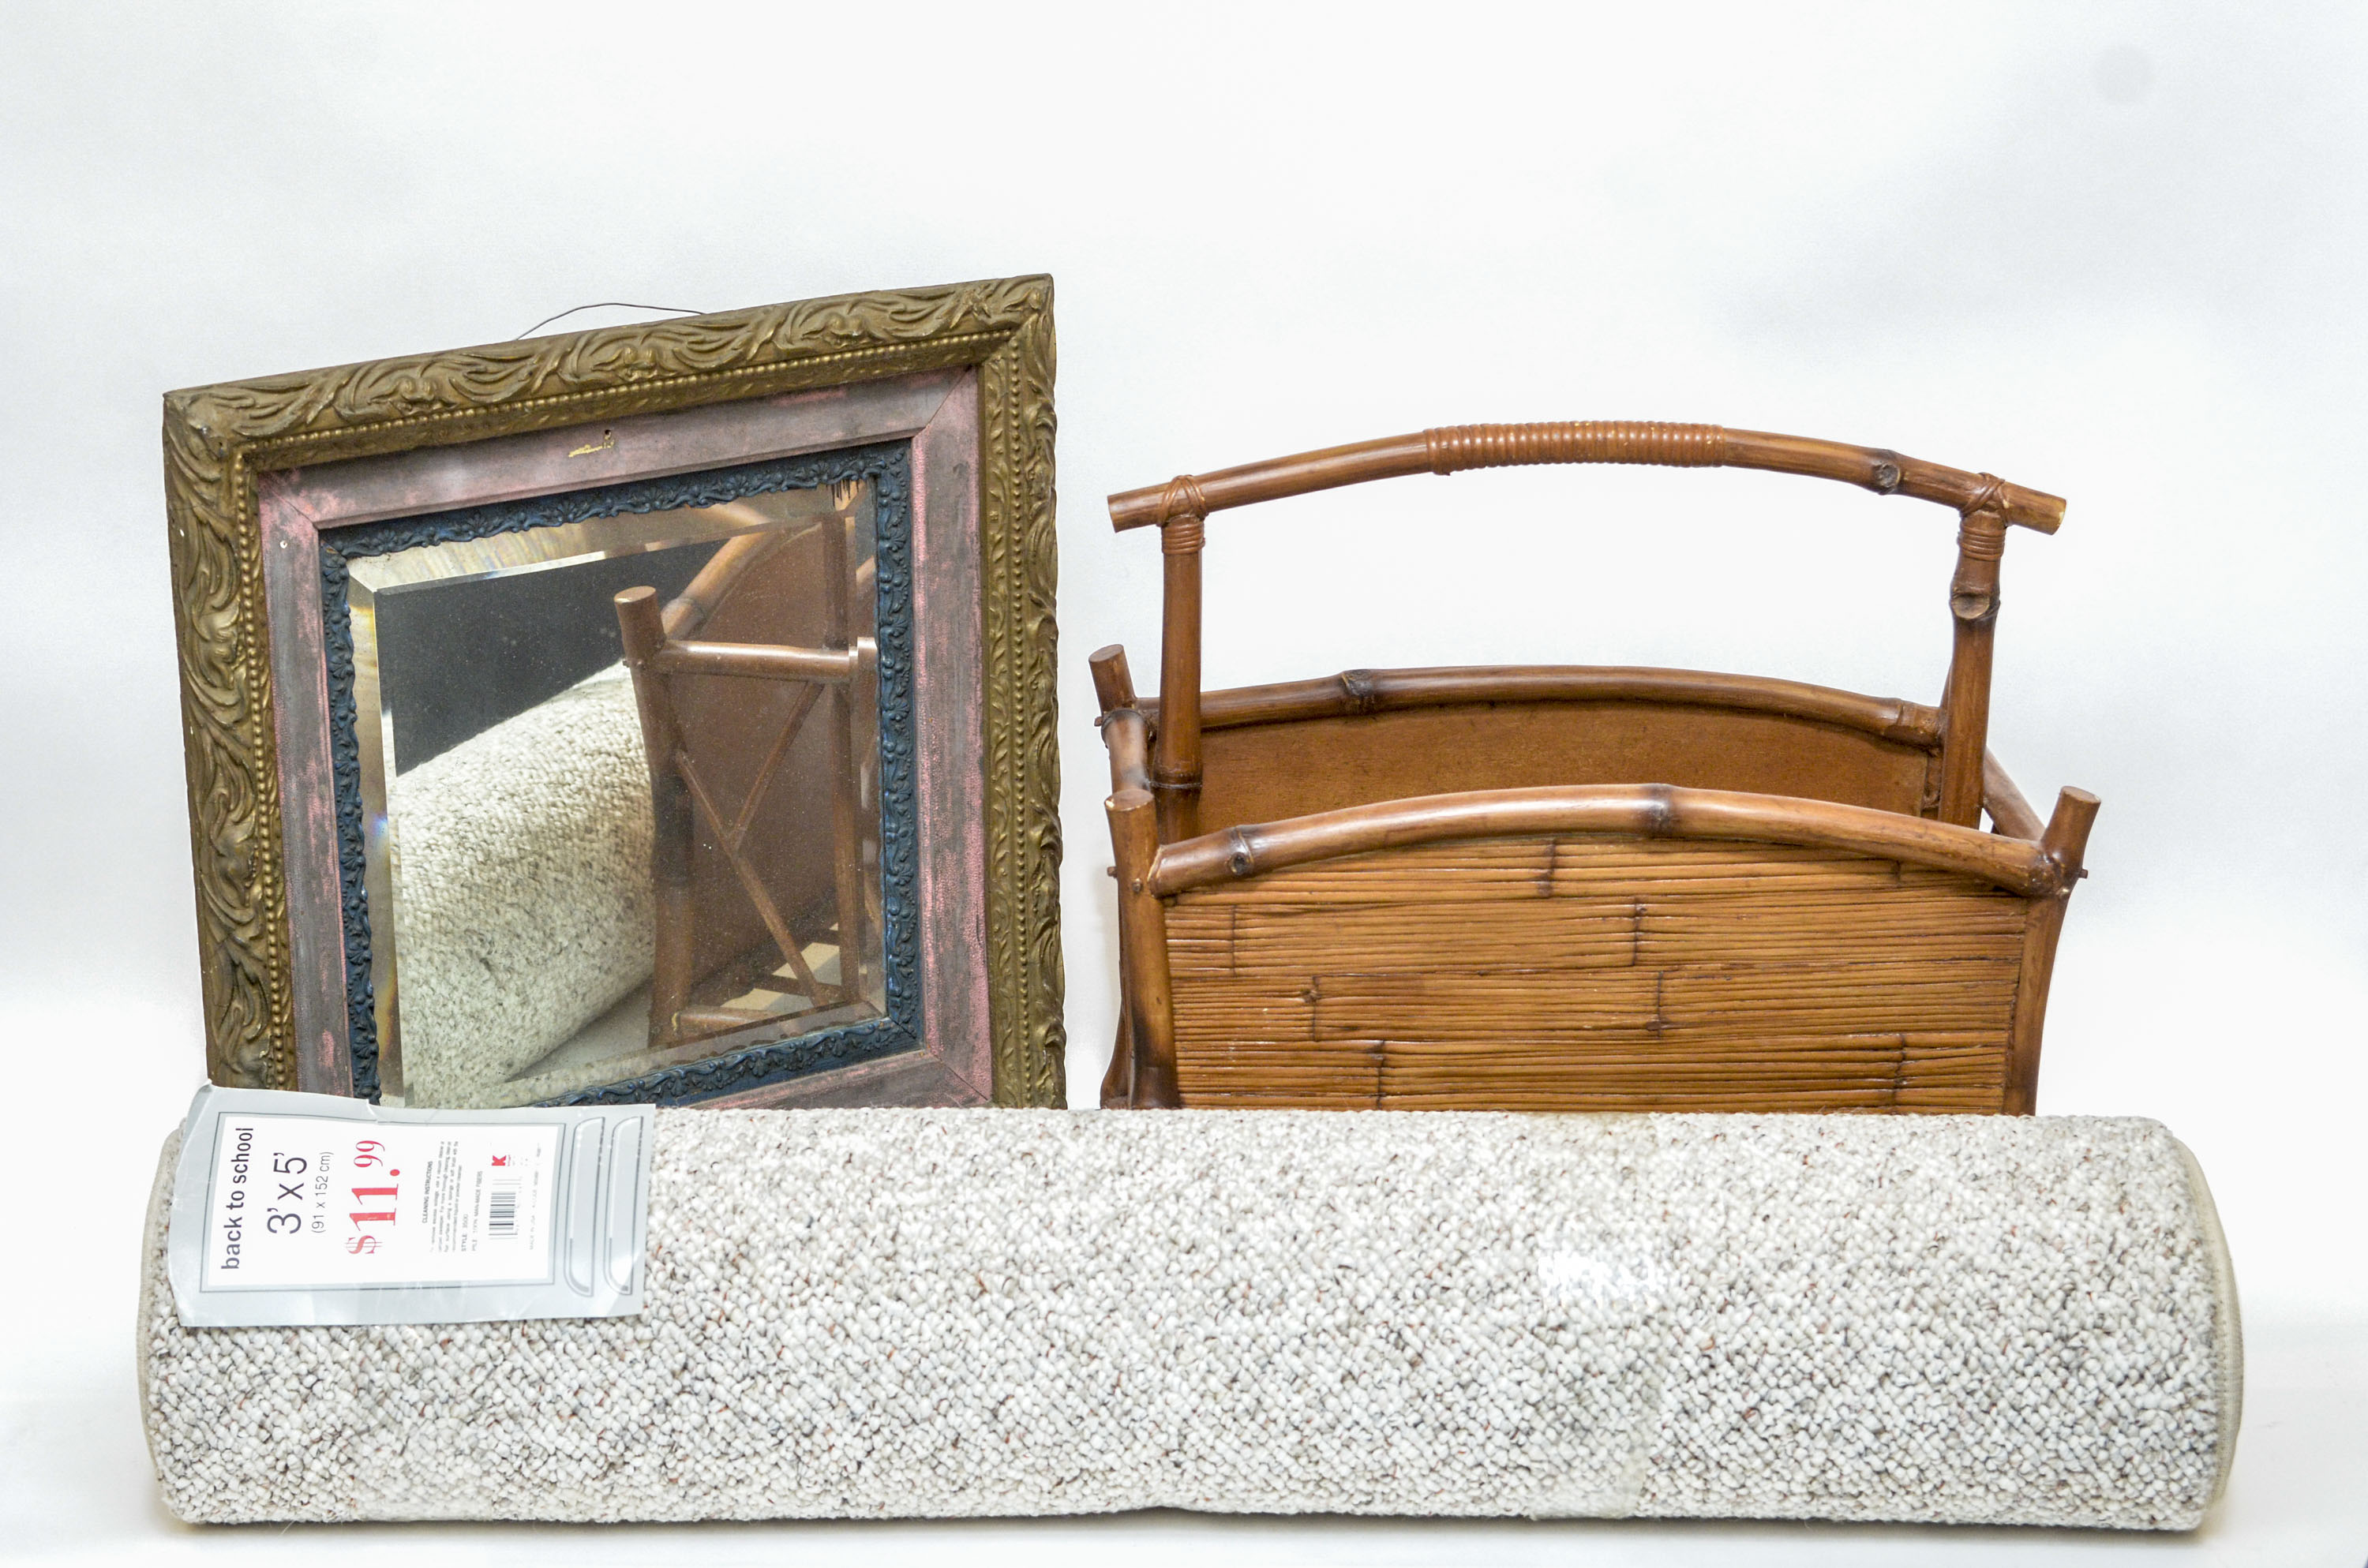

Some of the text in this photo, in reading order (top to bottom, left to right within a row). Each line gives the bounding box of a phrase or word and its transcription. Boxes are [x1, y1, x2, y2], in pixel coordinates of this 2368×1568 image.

[273, 1152, 307, 1174] 5'
[319, 1151, 335, 1172] cm)
[315, 1175, 328, 1197] 152
[424, 1161, 433, 1195] INSTRUCTIONS
[221, 1128, 253, 1269] back to school
[267, 1207, 302, 1234] 3'
[312, 1214, 325, 1233] (91
